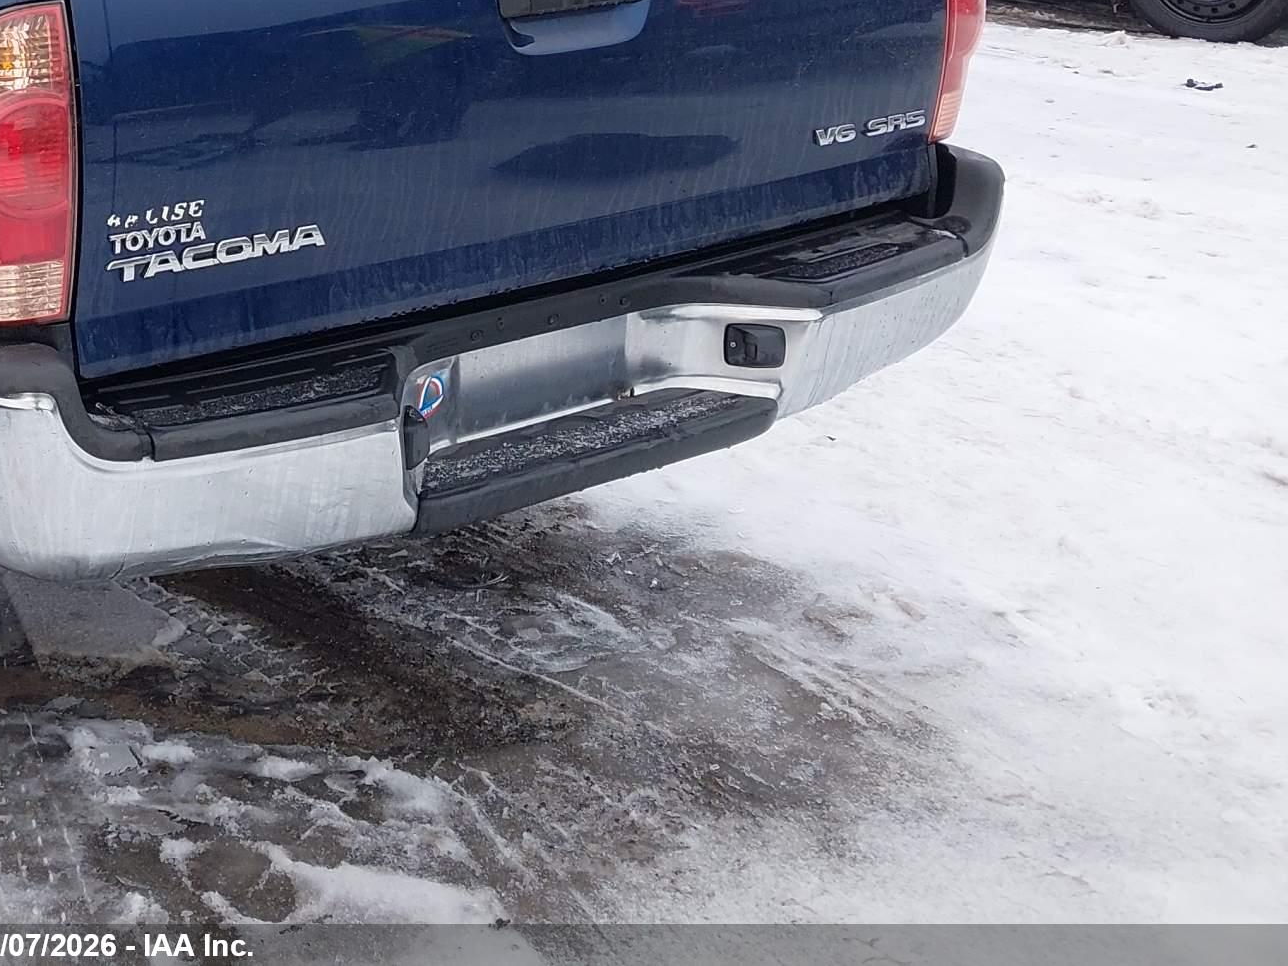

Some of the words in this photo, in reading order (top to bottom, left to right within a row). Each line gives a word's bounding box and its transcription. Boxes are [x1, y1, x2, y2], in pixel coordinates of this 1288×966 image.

[815, 123, 856, 146] V6
[865, 109, 926, 137] SR5
[106, 224, 326, 282] TACOMA
[109, 221, 206, 254] TOYOTA
